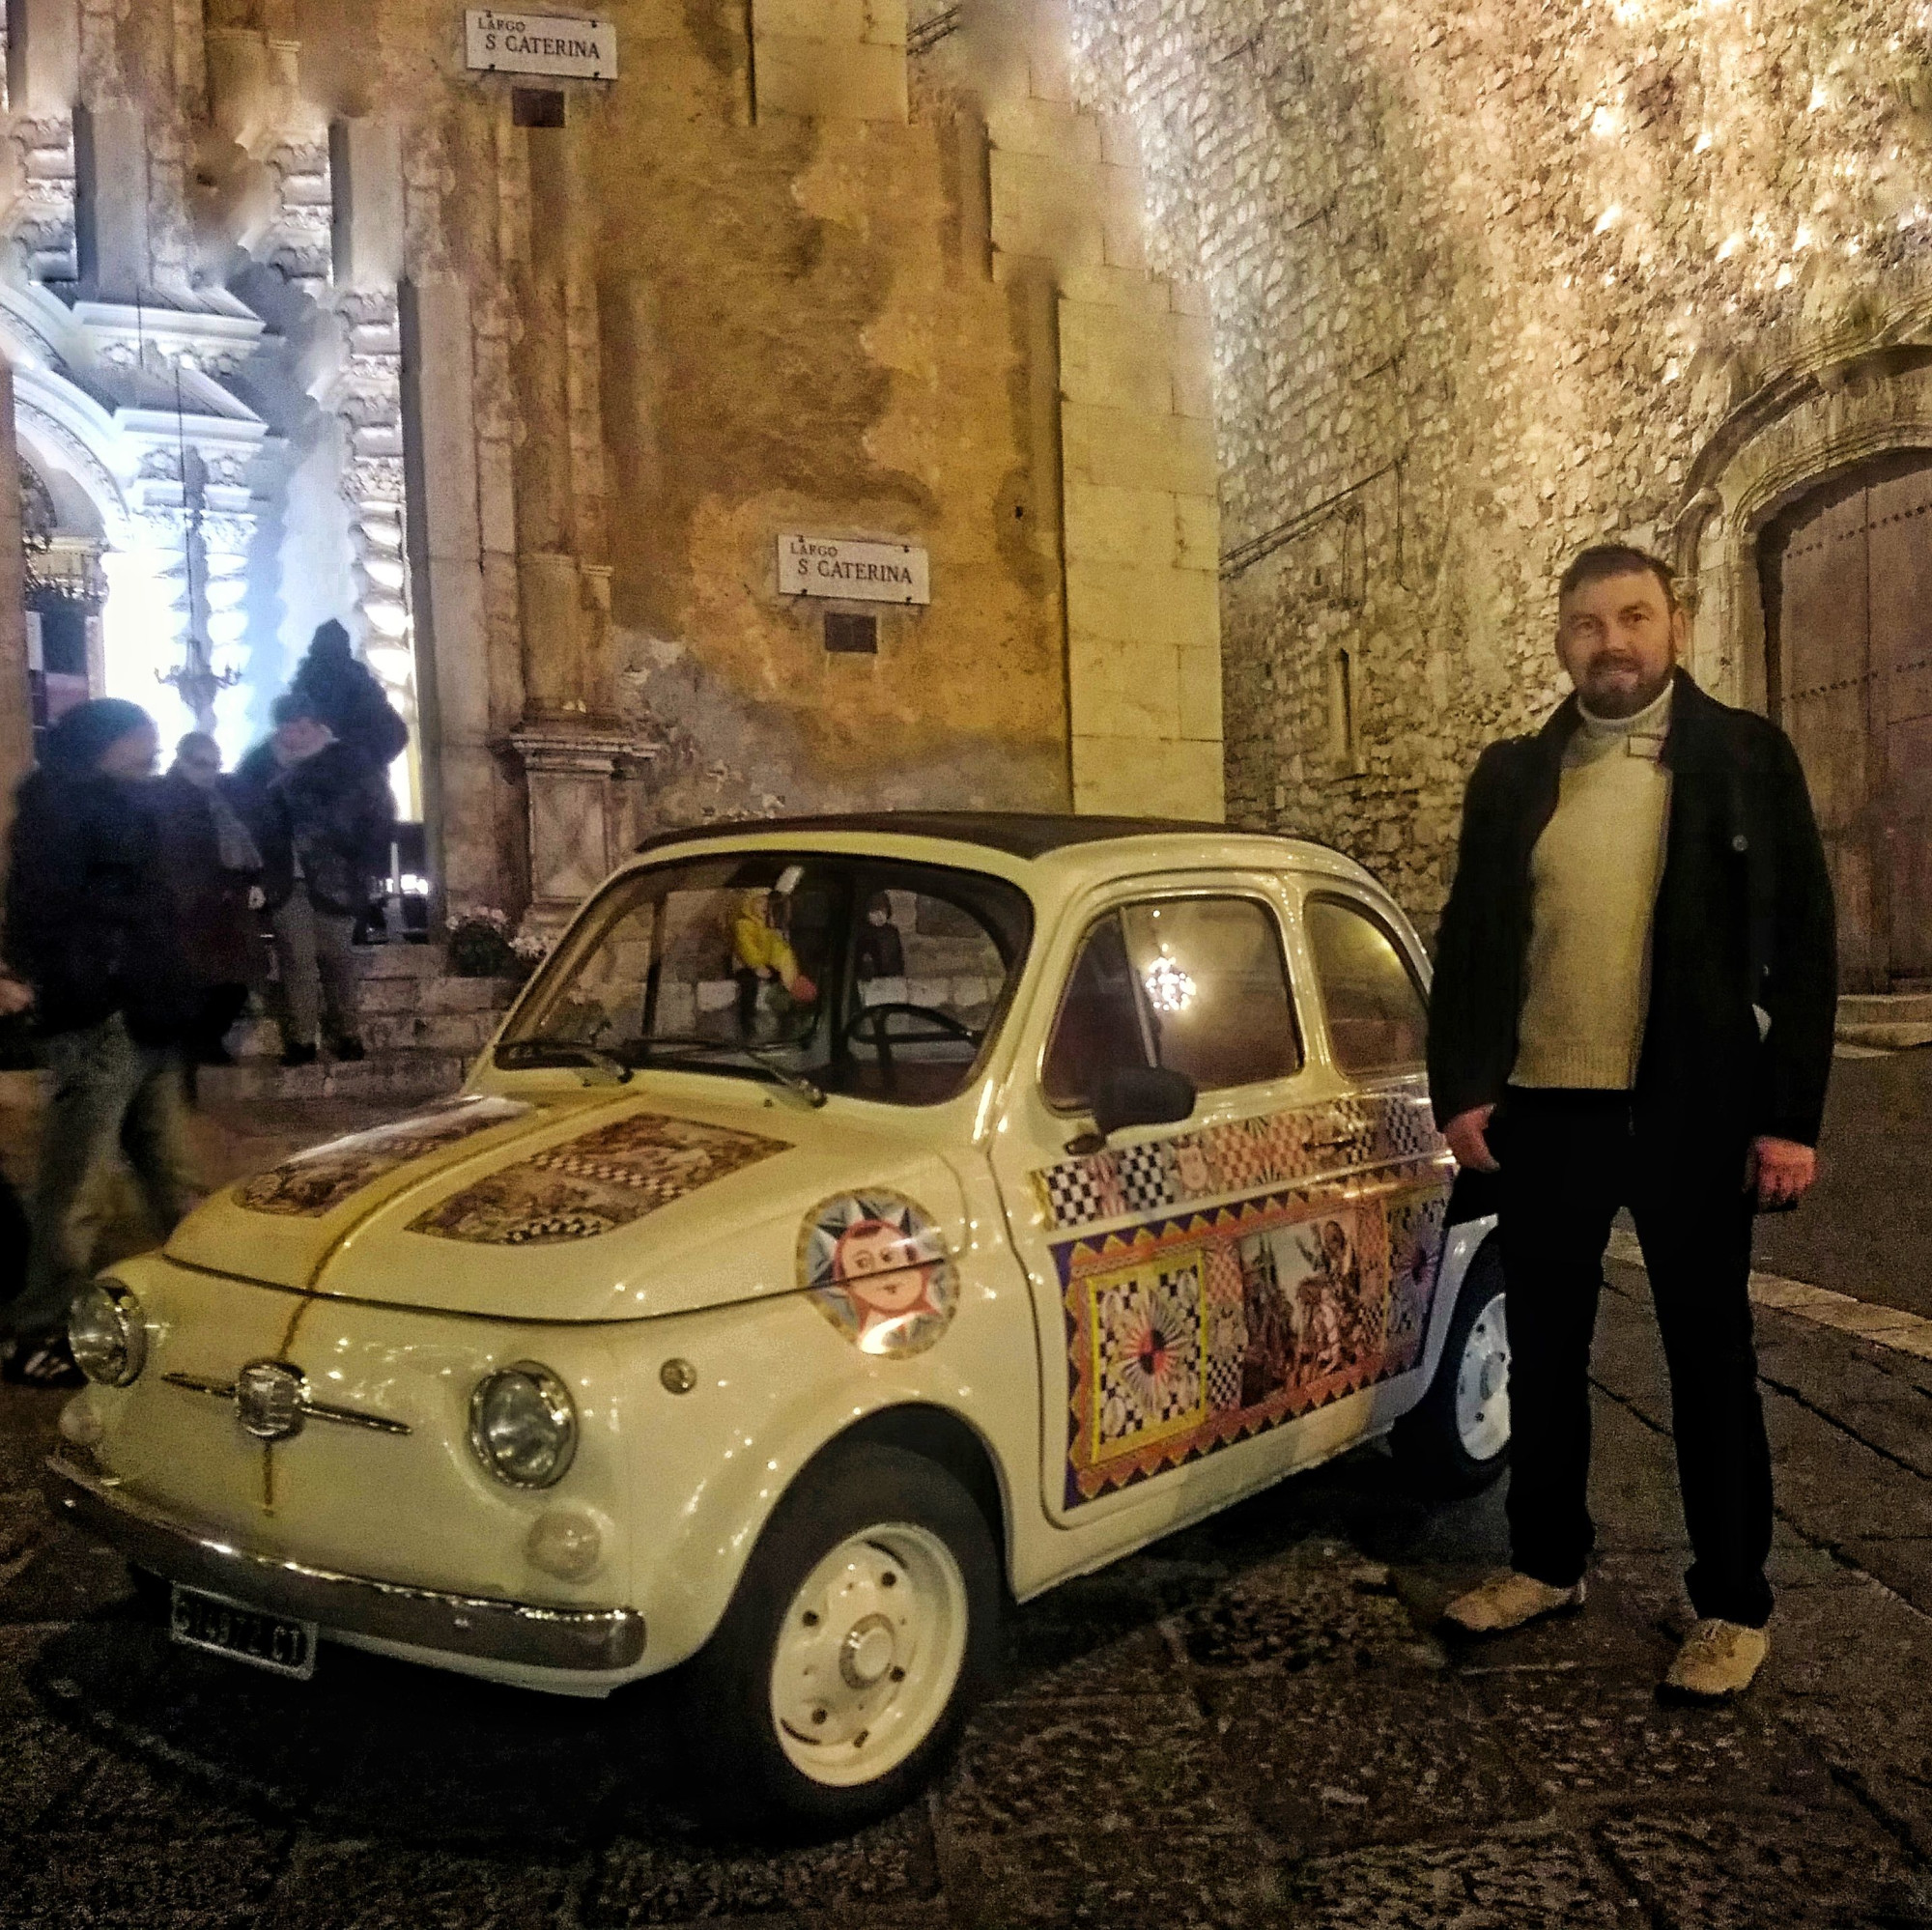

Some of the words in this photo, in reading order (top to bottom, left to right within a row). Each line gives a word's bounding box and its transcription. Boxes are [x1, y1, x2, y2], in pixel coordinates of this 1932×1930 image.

[478, 17, 526, 33] LARGO
[505, 35, 601, 59] CATERINA
[790, 542, 838, 557] LARGO
[817, 560, 913, 584] CATERINA
